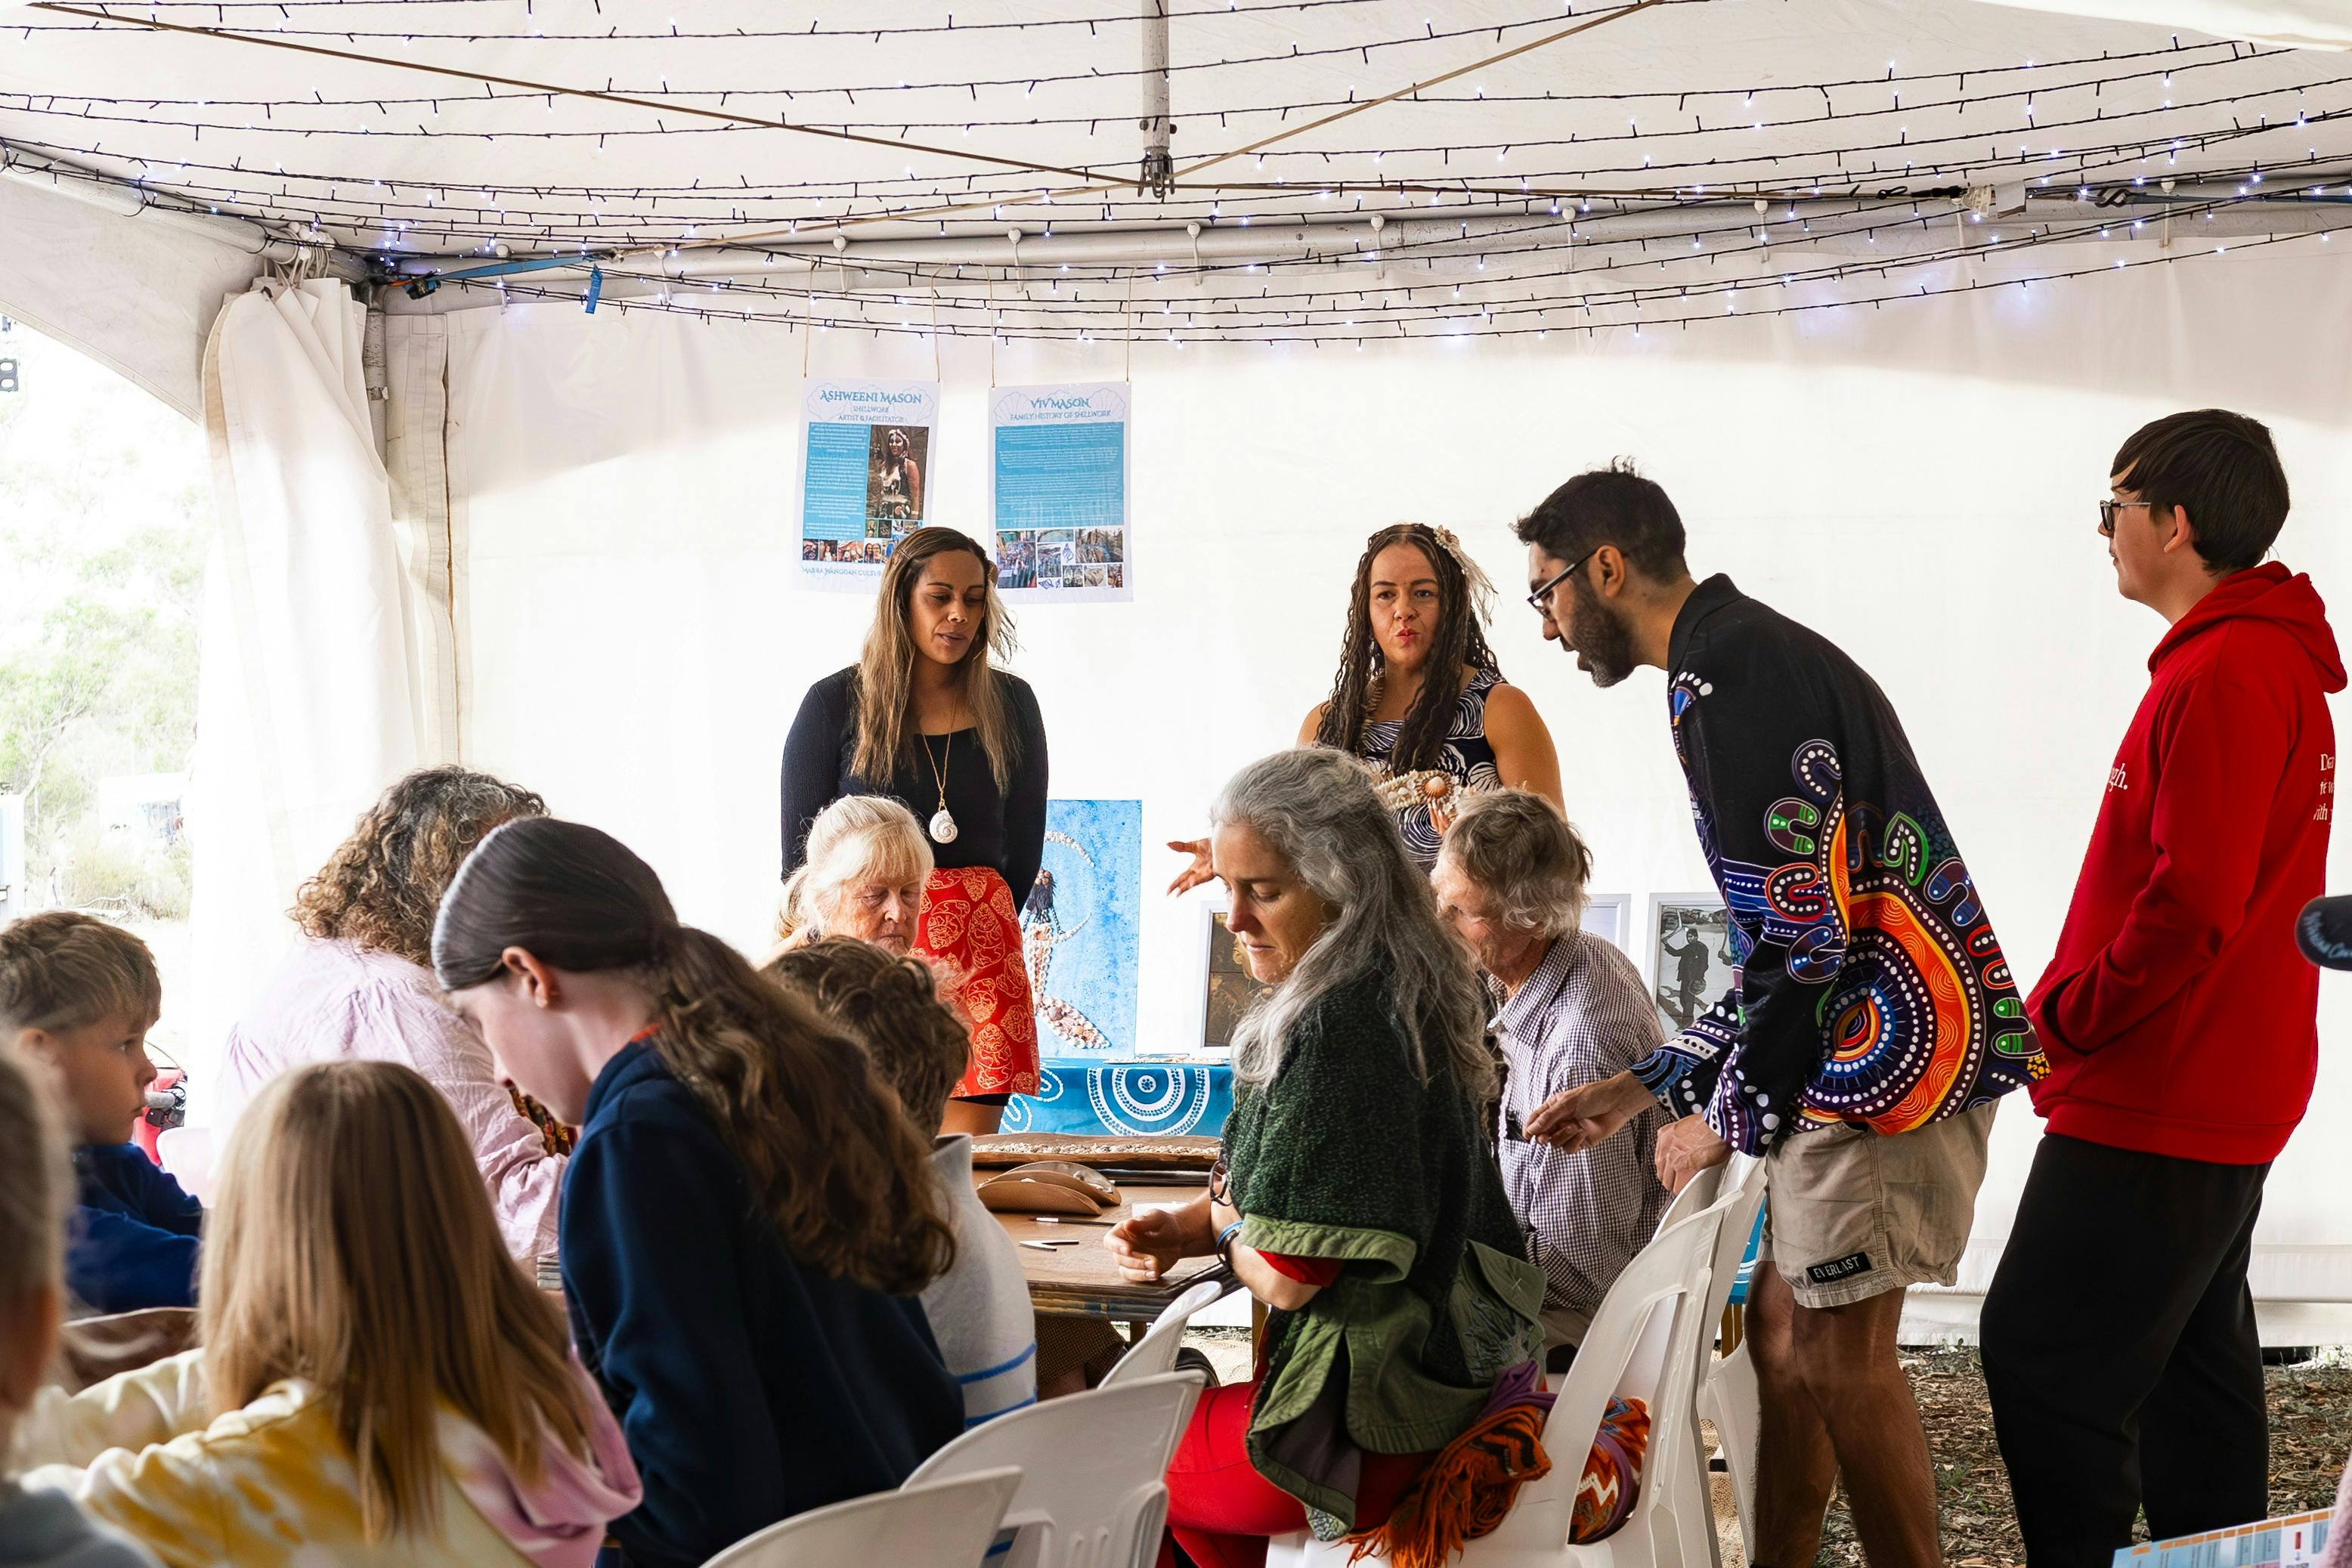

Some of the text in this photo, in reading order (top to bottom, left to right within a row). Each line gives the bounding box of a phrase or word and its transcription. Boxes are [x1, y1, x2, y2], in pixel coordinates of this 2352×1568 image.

[820, 390, 921, 404] ASHWEENI MASON
[1030, 397, 1092, 410] VIV MASON
[1813, 1256, 1859, 1279] EVERLAST
